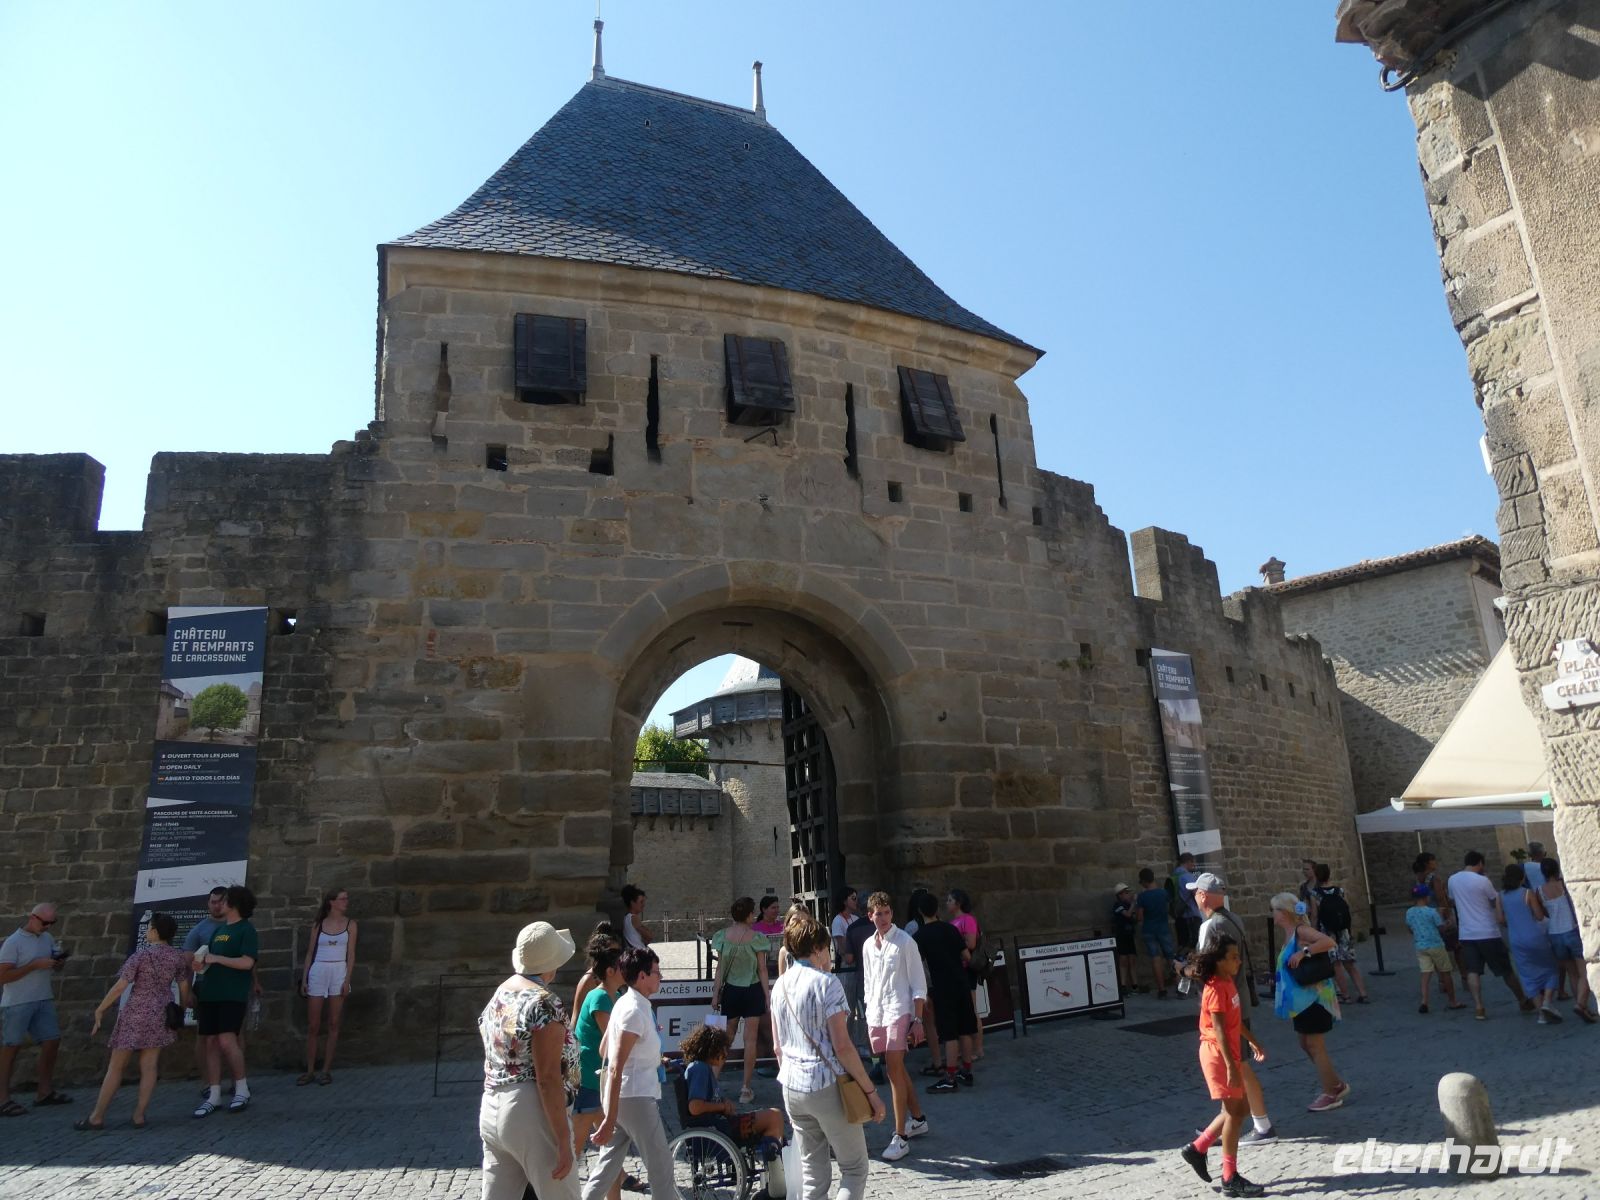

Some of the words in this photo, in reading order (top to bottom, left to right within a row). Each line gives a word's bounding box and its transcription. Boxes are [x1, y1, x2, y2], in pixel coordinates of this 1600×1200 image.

[174, 627, 226, 640] CHÂTEAU
[172, 641, 188, 652] ET
[192, 640, 255, 652] REMPARTS
[186, 654, 246, 662] CARCASSONNE
[660, 984, 690, 994] ACCÈS
